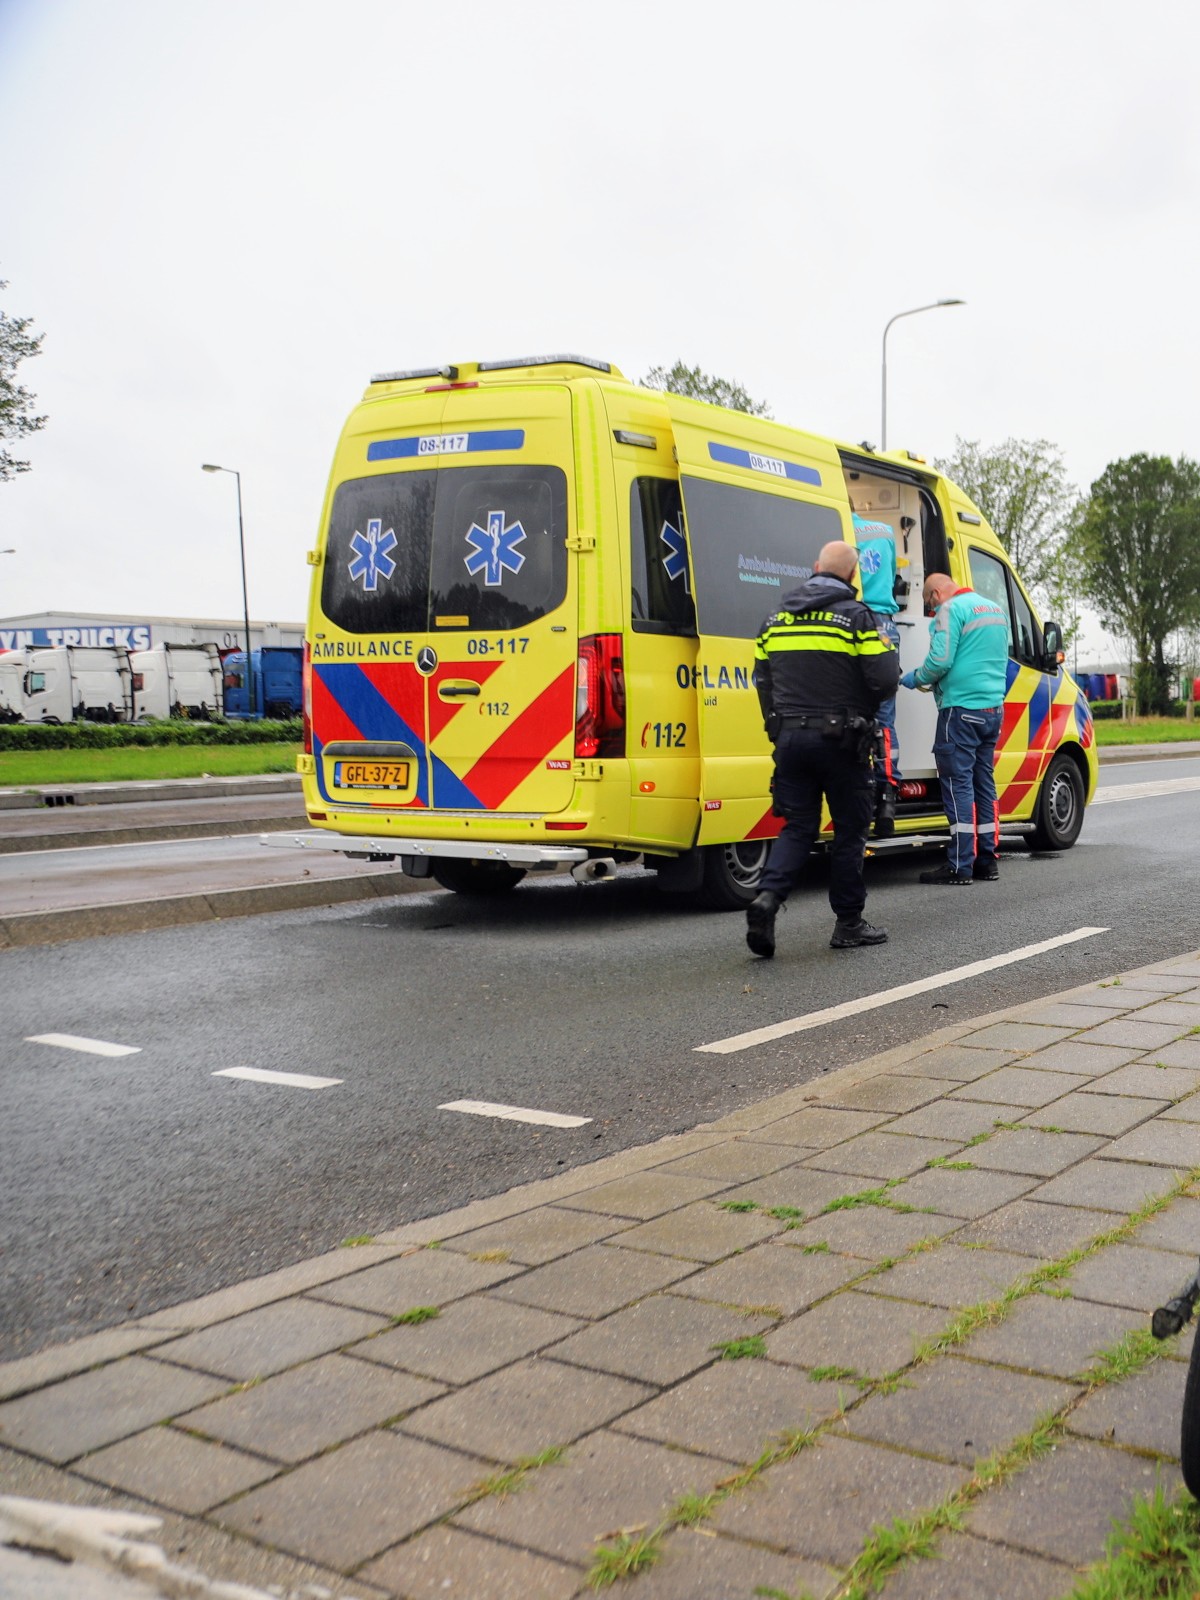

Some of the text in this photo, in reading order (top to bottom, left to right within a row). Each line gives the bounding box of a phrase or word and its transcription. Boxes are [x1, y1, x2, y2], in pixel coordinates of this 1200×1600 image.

[420, 437, 465, 452] 08-117
[750, 456, 783, 474] 08-117
[46, 627, 149, 650] TRUCKS
[313, 638, 530, 657] AMBULANCE 08-117
[548, 760, 569, 769] WAS
[346, 765, 402, 782] GFL-37-Z
[706, 802, 721, 810] WAS
